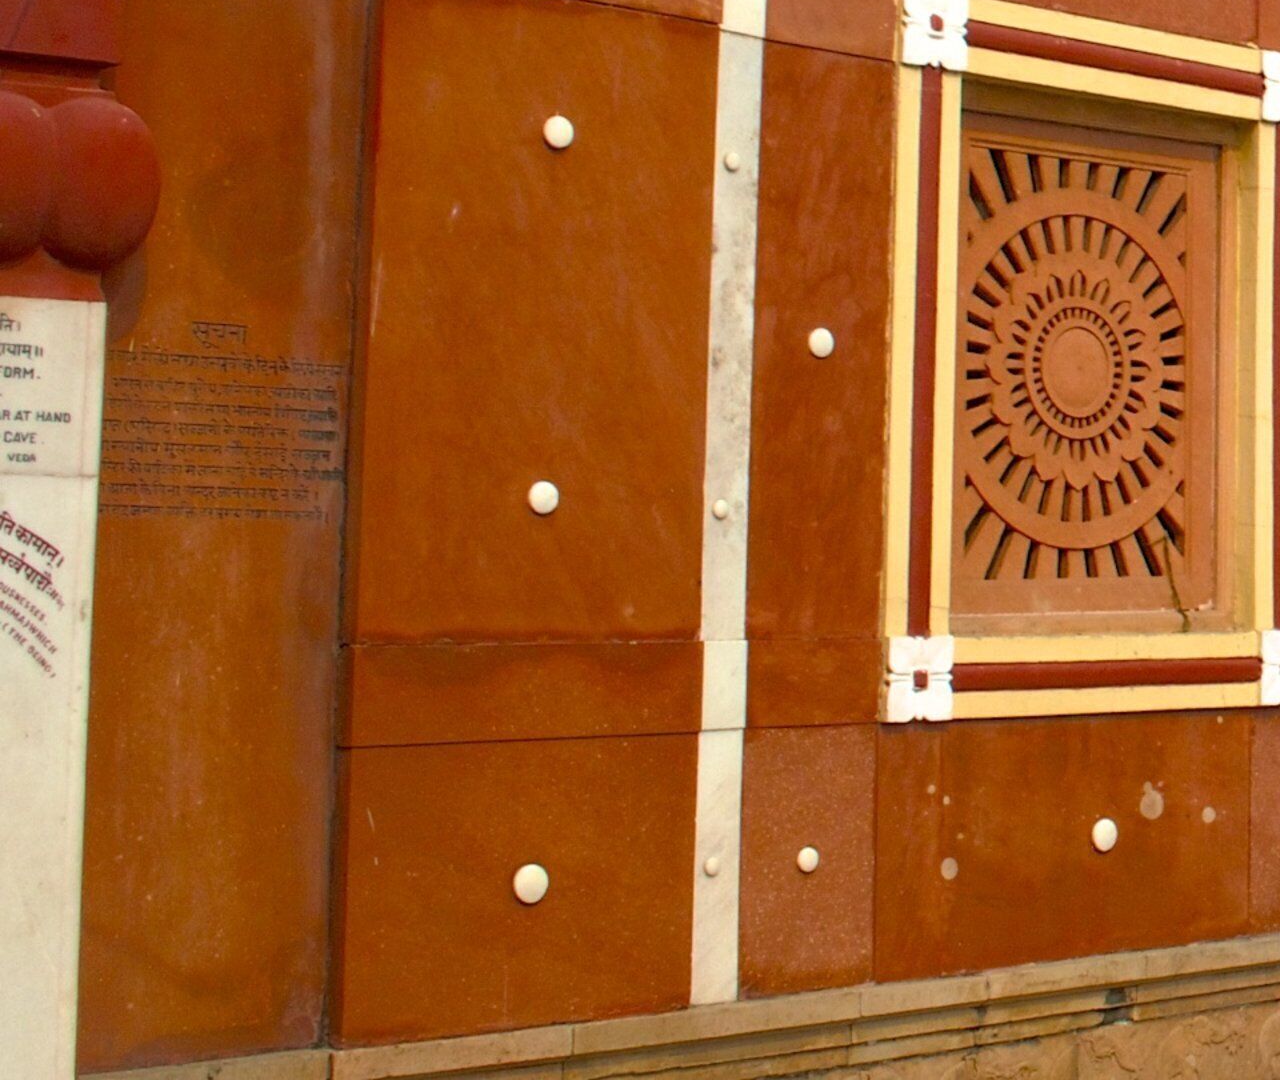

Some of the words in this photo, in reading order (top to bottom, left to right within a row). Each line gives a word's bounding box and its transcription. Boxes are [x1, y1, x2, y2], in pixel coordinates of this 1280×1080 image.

[14, 410, 31, 421] AT
[36, 410, 72, 423] HAND
[7, 453, 36, 463] VEDA
